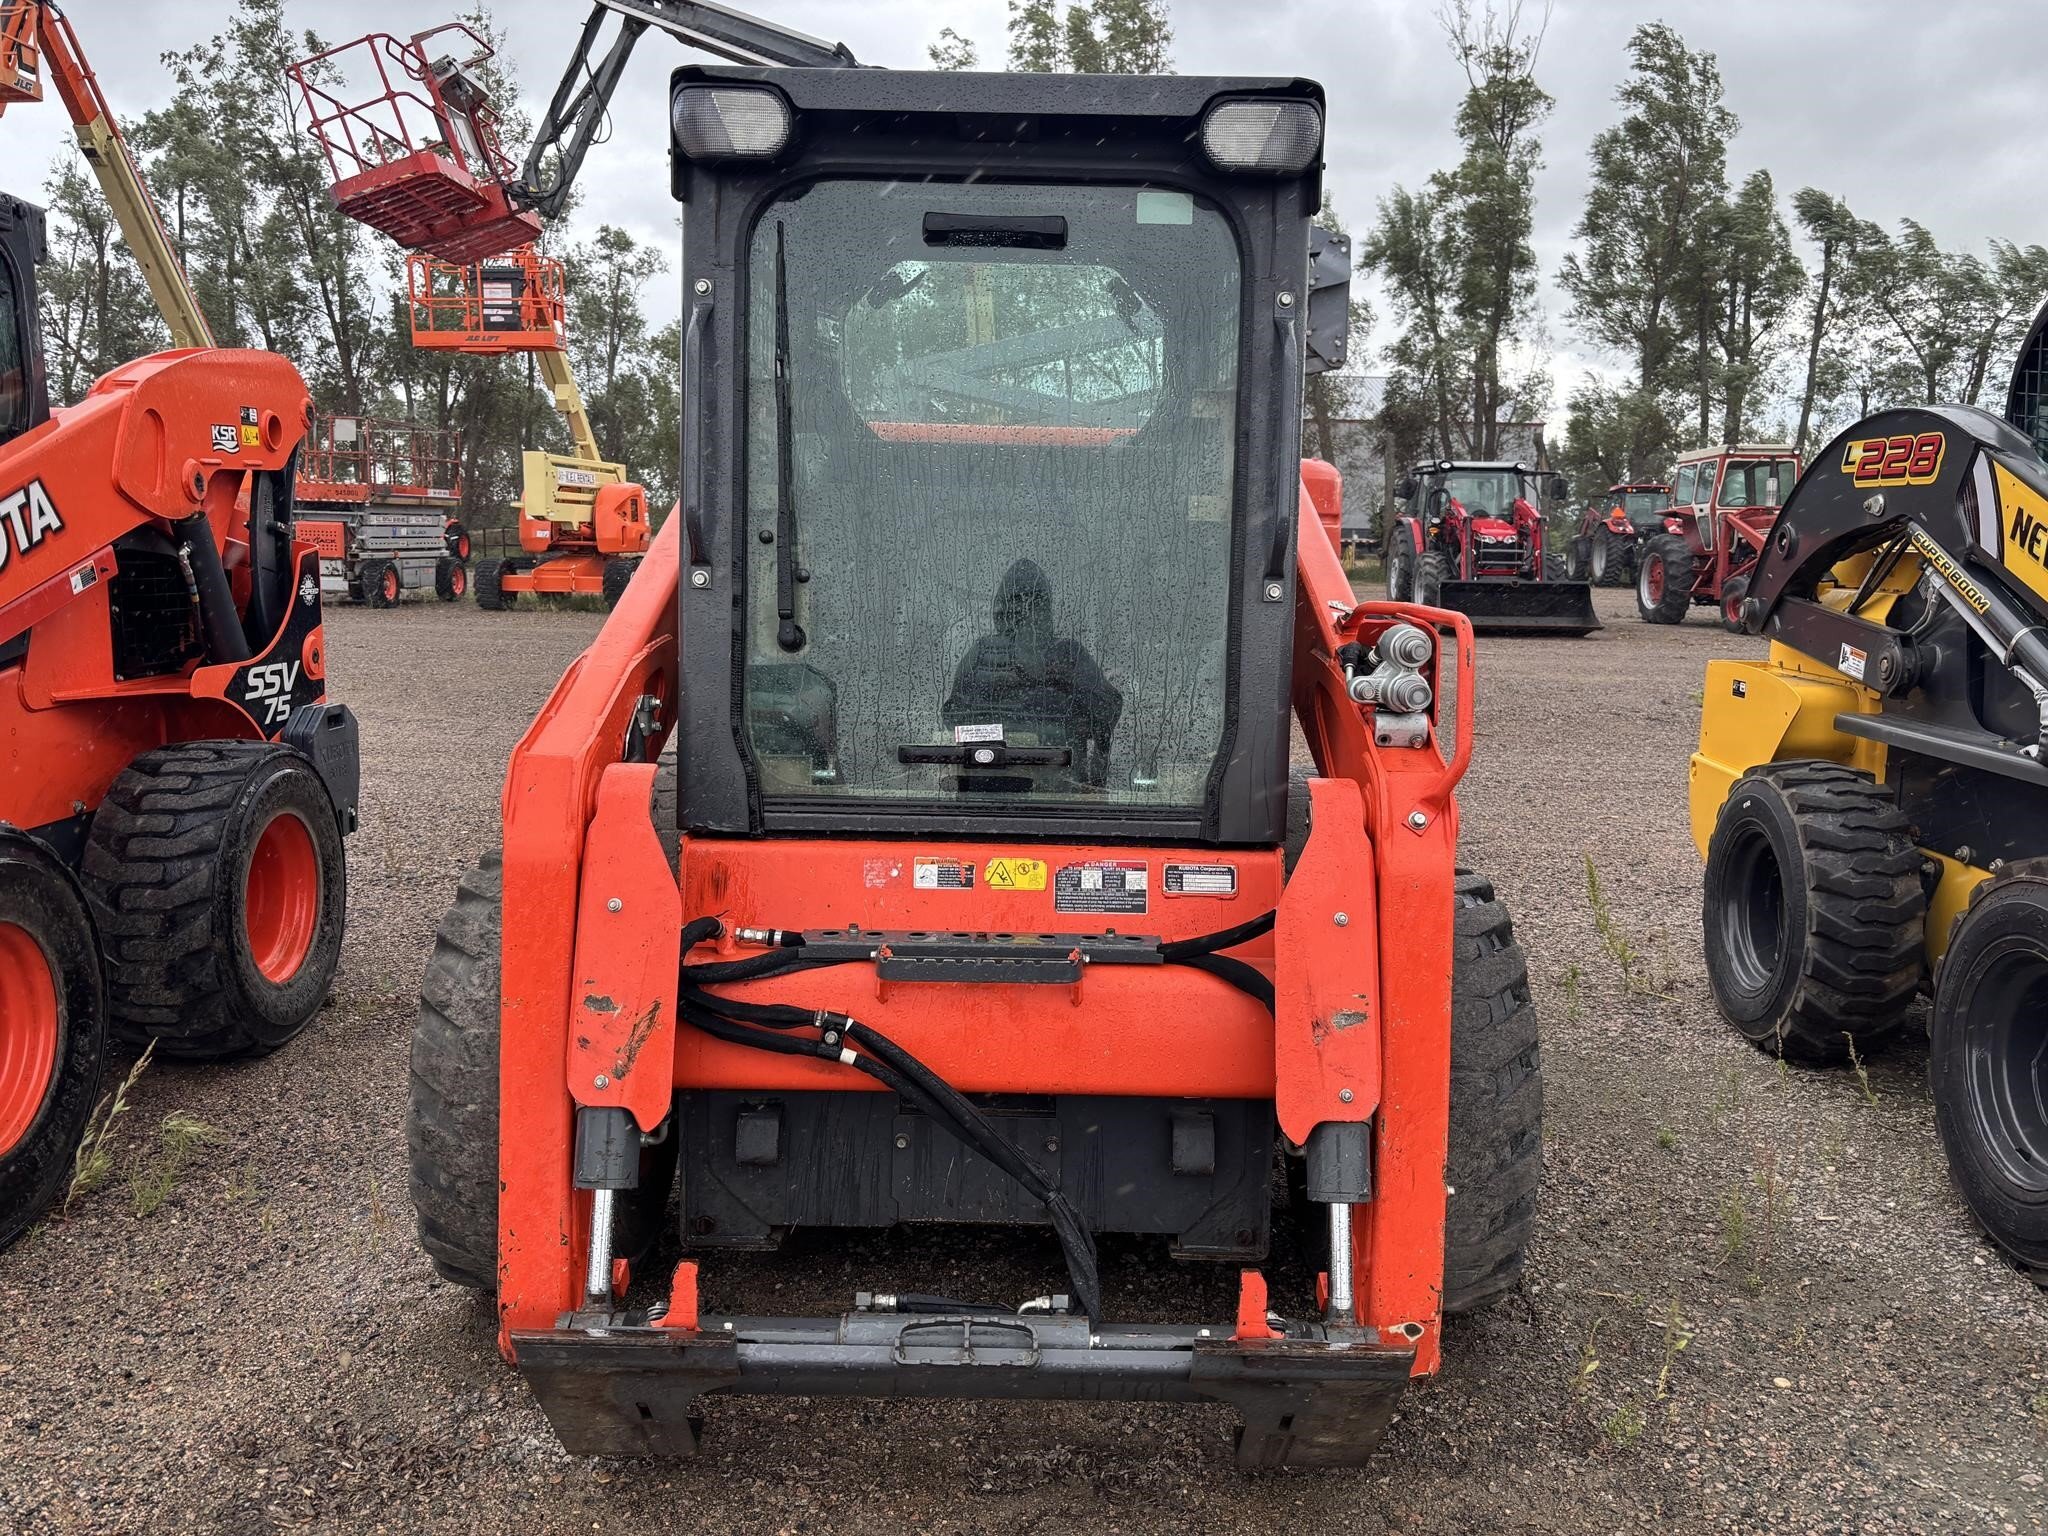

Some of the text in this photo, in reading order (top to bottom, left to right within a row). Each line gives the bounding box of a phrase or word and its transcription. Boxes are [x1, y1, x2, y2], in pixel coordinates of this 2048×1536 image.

[14, 78, 33, 93] JLG
[211, 425, 237, 441] KSR
[1842, 432, 1945, 487] L228
[1911, 530, 1955, 580] SUPER
[2010, 505, 2048, 570] NE
[1949, 568, 1992, 615] BOOM
[245, 660, 300, 710] SSV
[264, 694, 292, 725] 75
